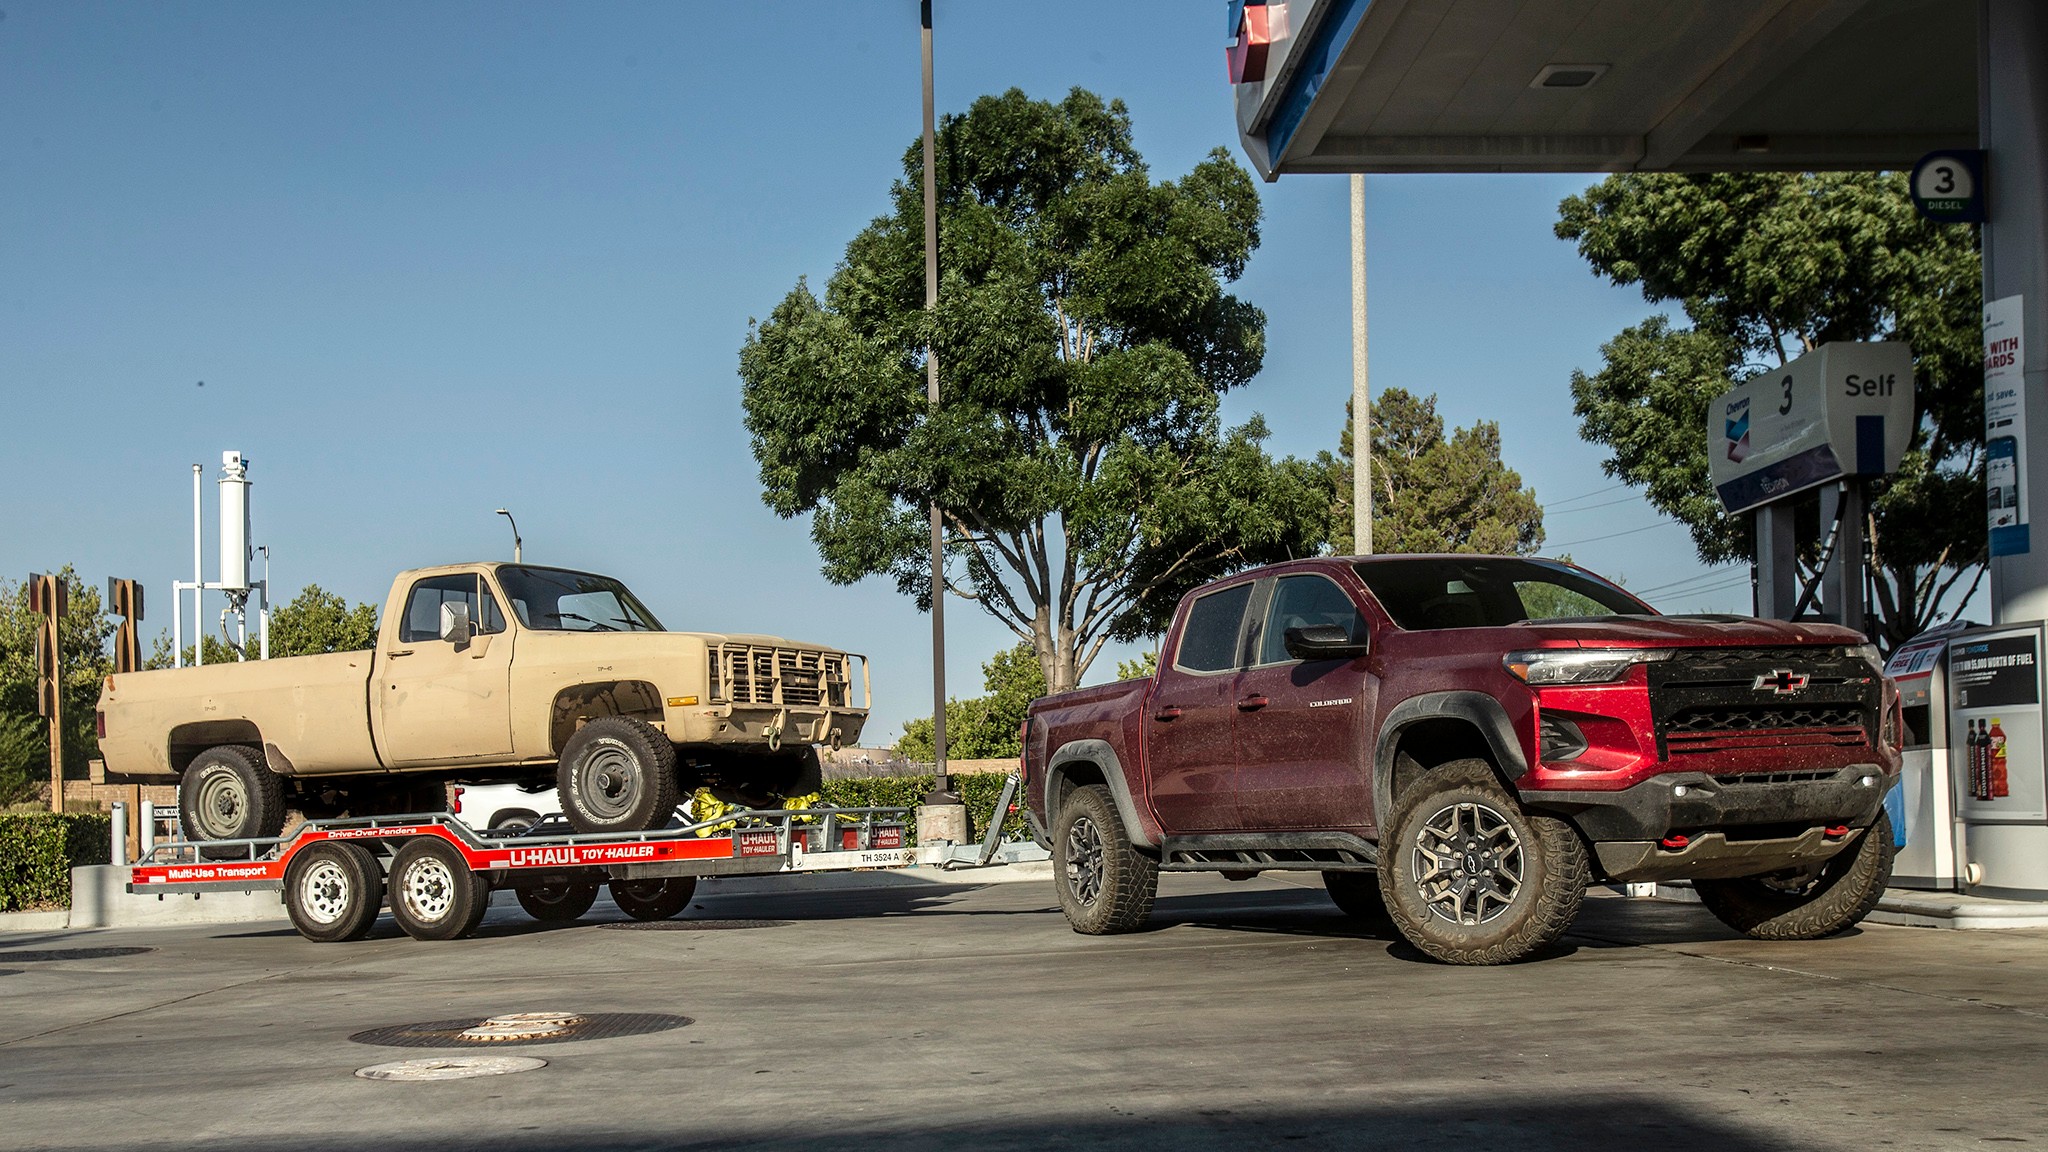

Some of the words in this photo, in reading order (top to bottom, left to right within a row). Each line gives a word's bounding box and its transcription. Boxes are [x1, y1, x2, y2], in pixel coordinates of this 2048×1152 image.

[1934, 166, 1955, 194] 3
[1928, 201, 1963, 209] DIESEL
[1990, 336, 2019, 354] WITH
[1845, 374, 1895, 397] Self
[1778, 374, 1793, 416] 3
[1726, 396, 1751, 416] Chevron
[1987, 655, 2008, 668] WORTH
[2008, 654, 2016, 666] OF
[1309, 697, 1352, 708] COLORADO
[328, 829, 378, 838] Drive-Over
[379, 827, 417, 836] Fenders
[741, 833, 776, 844] U-HAUL
[510, 848, 581, 866] U-HAUL
[861, 854, 872, 862] TH
[873, 853, 892, 862] 3524
[893, 852, 900, 861] A
[168, 868, 215, 879] Multi-Use
[216, 865, 267, 878] Transport
